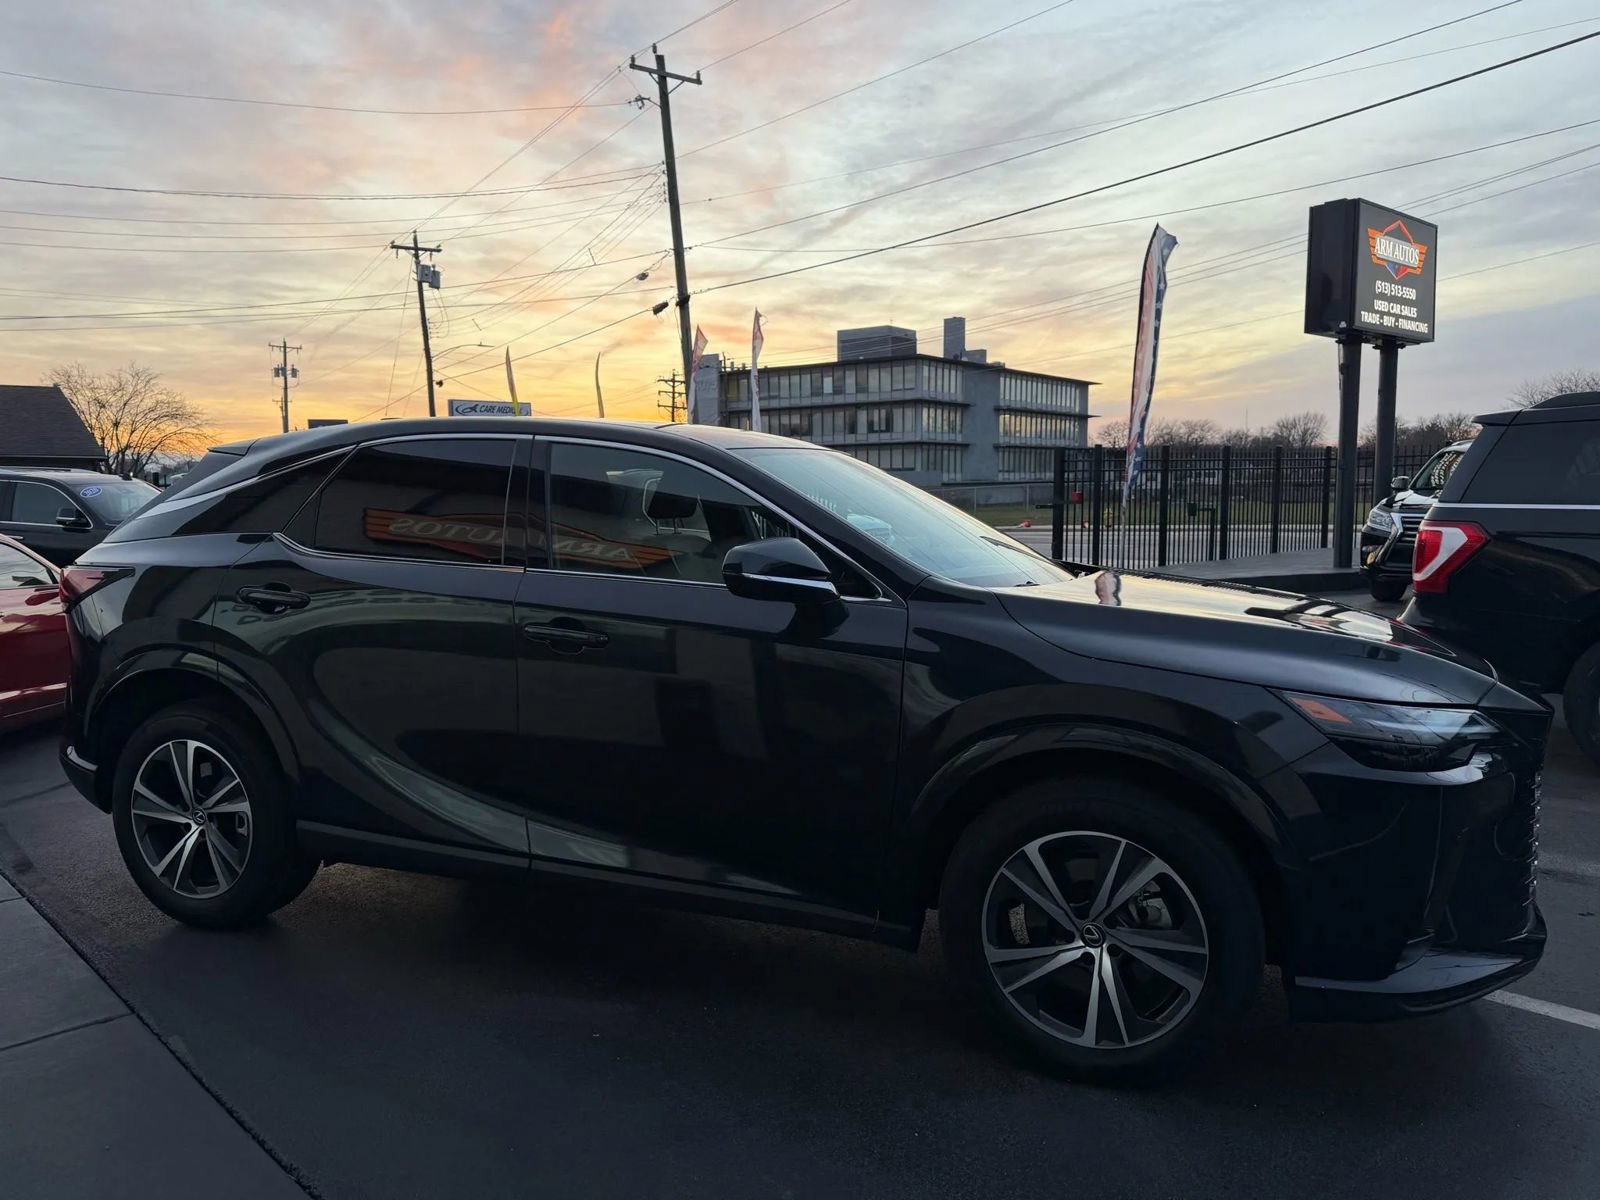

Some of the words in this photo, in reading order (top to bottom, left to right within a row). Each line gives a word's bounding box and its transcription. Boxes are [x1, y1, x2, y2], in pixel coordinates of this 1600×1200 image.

[1375, 238, 1393, 257] ARM
[1394, 244, 1419, 264] AUTOS
[1376, 280, 1390, 296] (513)
[1374, 299, 1388, 312] USED
[1390, 302, 1401, 314] CAR
[1401, 305, 1417, 318] SALES
[1361, 311, 1380, 324] TRADE
[1383, 315, 1395, 328] BUY
[1398, 318, 1428, 333] FINANCING
[480, 405, 496, 413] CARE
